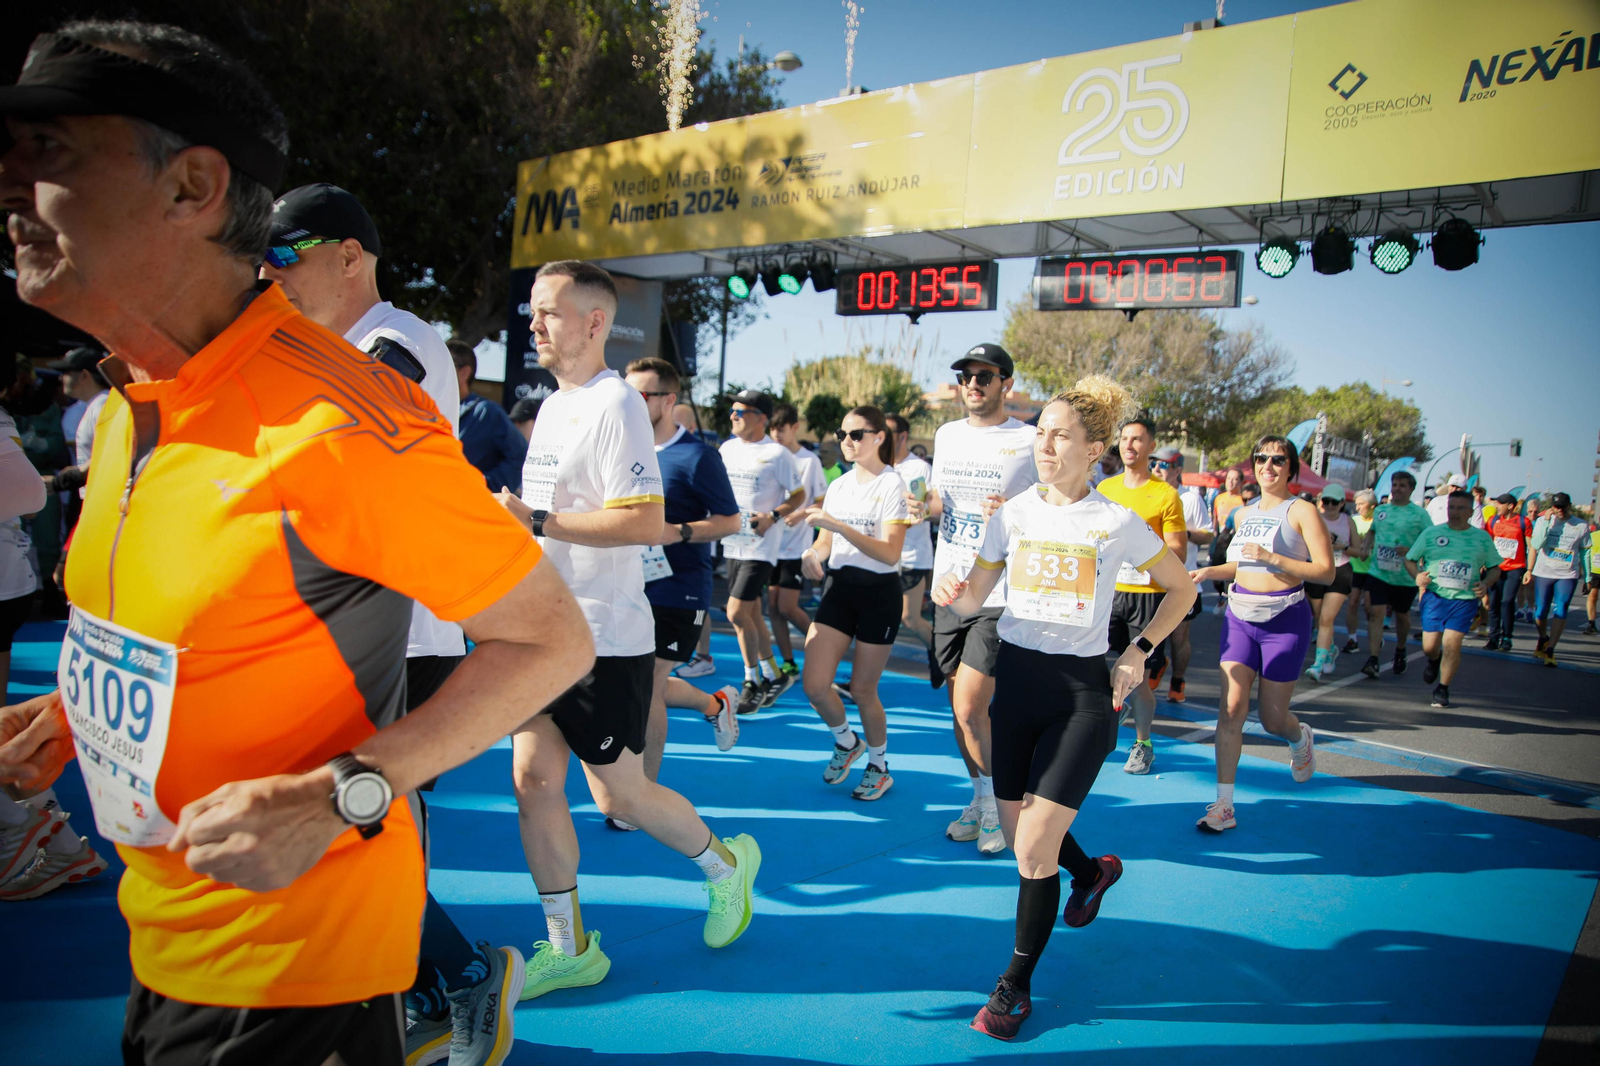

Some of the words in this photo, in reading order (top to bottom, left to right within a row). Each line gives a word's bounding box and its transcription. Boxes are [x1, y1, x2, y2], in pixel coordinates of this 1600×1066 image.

[1057, 53, 1190, 167] 25
[1325, 93, 1432, 119] COOPERACIÓN
[1469, 89, 1497, 102] 2020
[1324, 116, 1359, 131] 2005
[611, 174, 660, 198] Medio
[665, 162, 742, 189] Maratón
[751, 188, 800, 209] RAMÓN
[806, 185, 841, 201] RUIZ
[846, 175, 921, 198] ANDÚJAR
[1053, 159, 1185, 200] EDICIÓN
[609, 193, 678, 225] Almería
[683, 186, 740, 216] 2024
[857, 265, 982, 311] 00:13:55
[941, 467, 973, 478] Almería
[974, 469, 1002, 480] 2024
[943, 515, 980, 539] 5573
[1025, 552, 1079, 581] 533
[1040, 579, 1057, 587] ANA
[67, 646, 154, 743] 5109
[68, 705, 109, 744] FRANCISCO
[111, 736, 144, 764] JESUS
[481, 992, 498, 1036] HOKA
